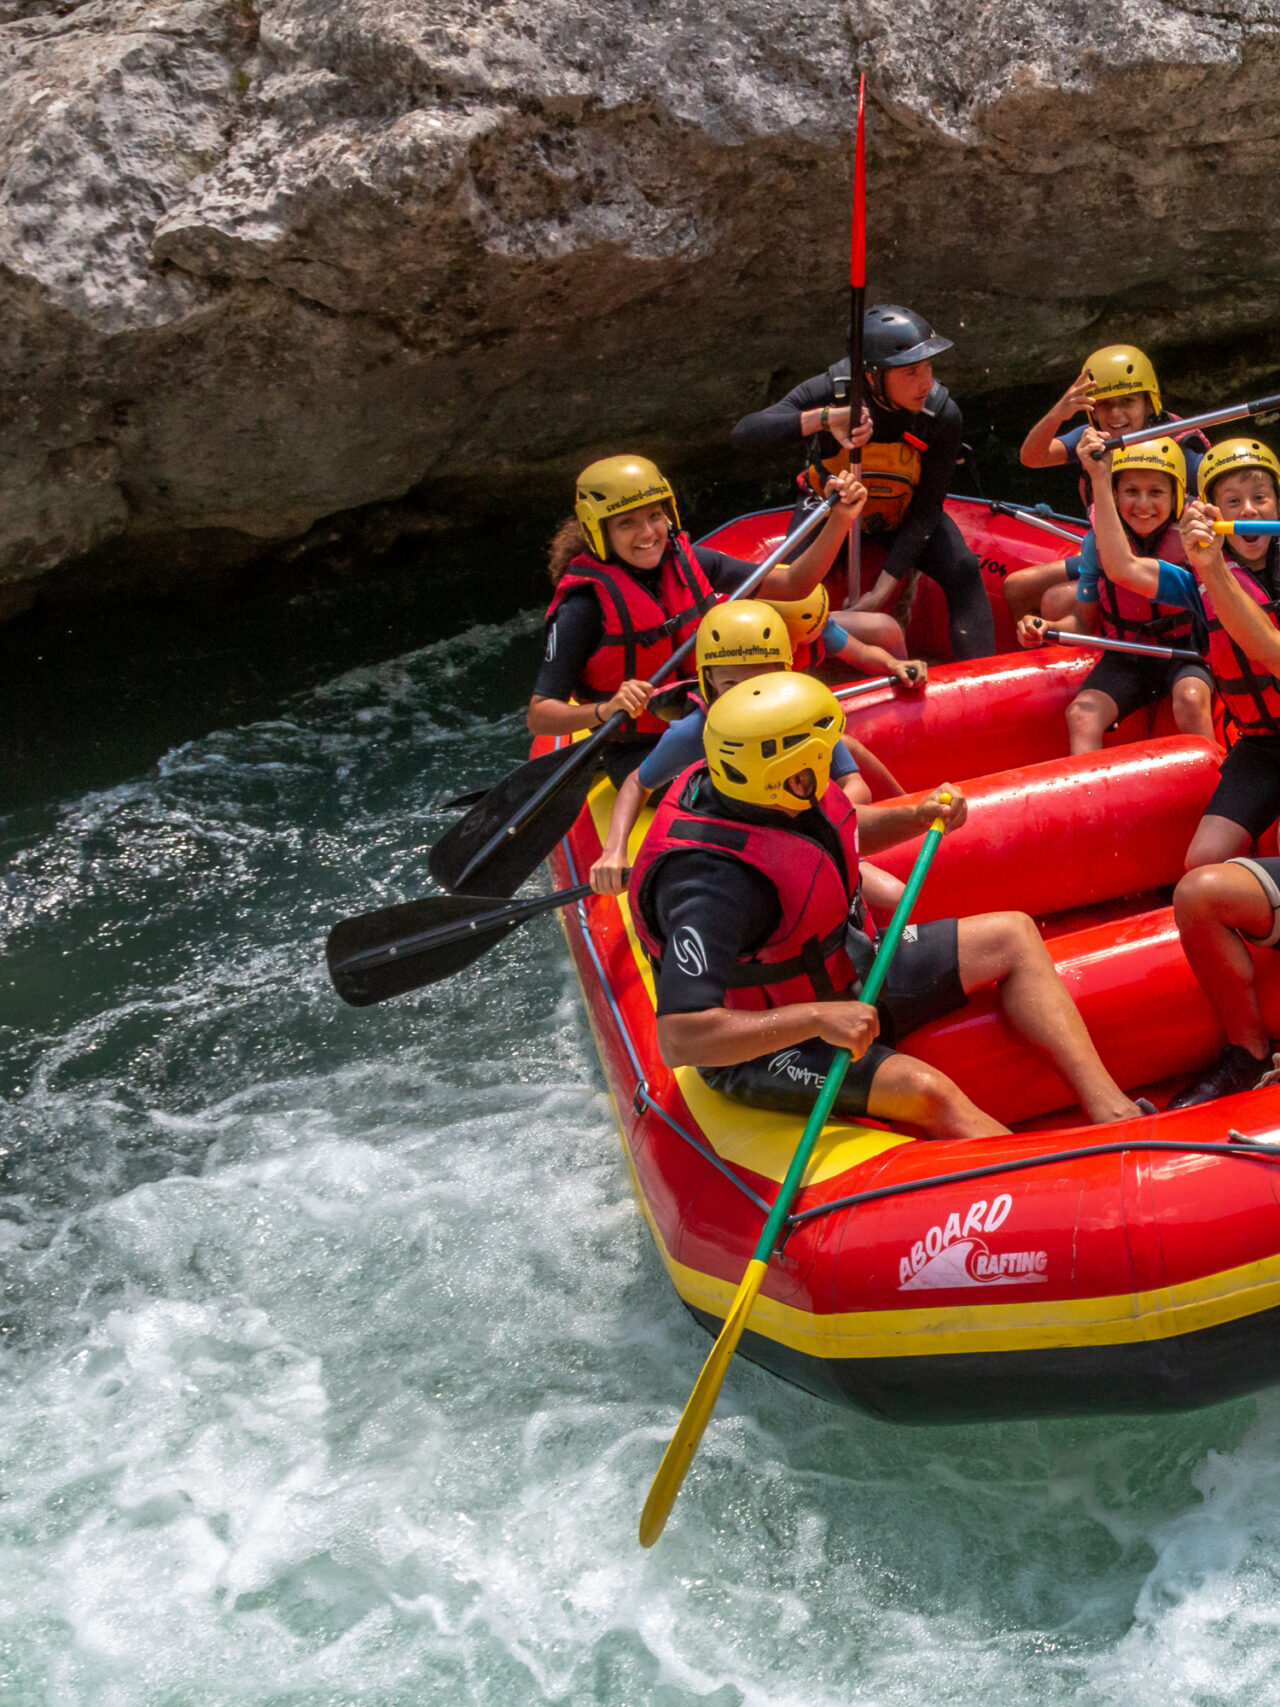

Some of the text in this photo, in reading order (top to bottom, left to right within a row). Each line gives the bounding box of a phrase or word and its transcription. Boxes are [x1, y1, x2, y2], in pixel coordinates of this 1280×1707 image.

[704, 644, 780, 660] www.aboard-rafting.com
[899, 1194, 1012, 1285] ABOARD
[976, 1250, 1048, 1275] RAFTING
